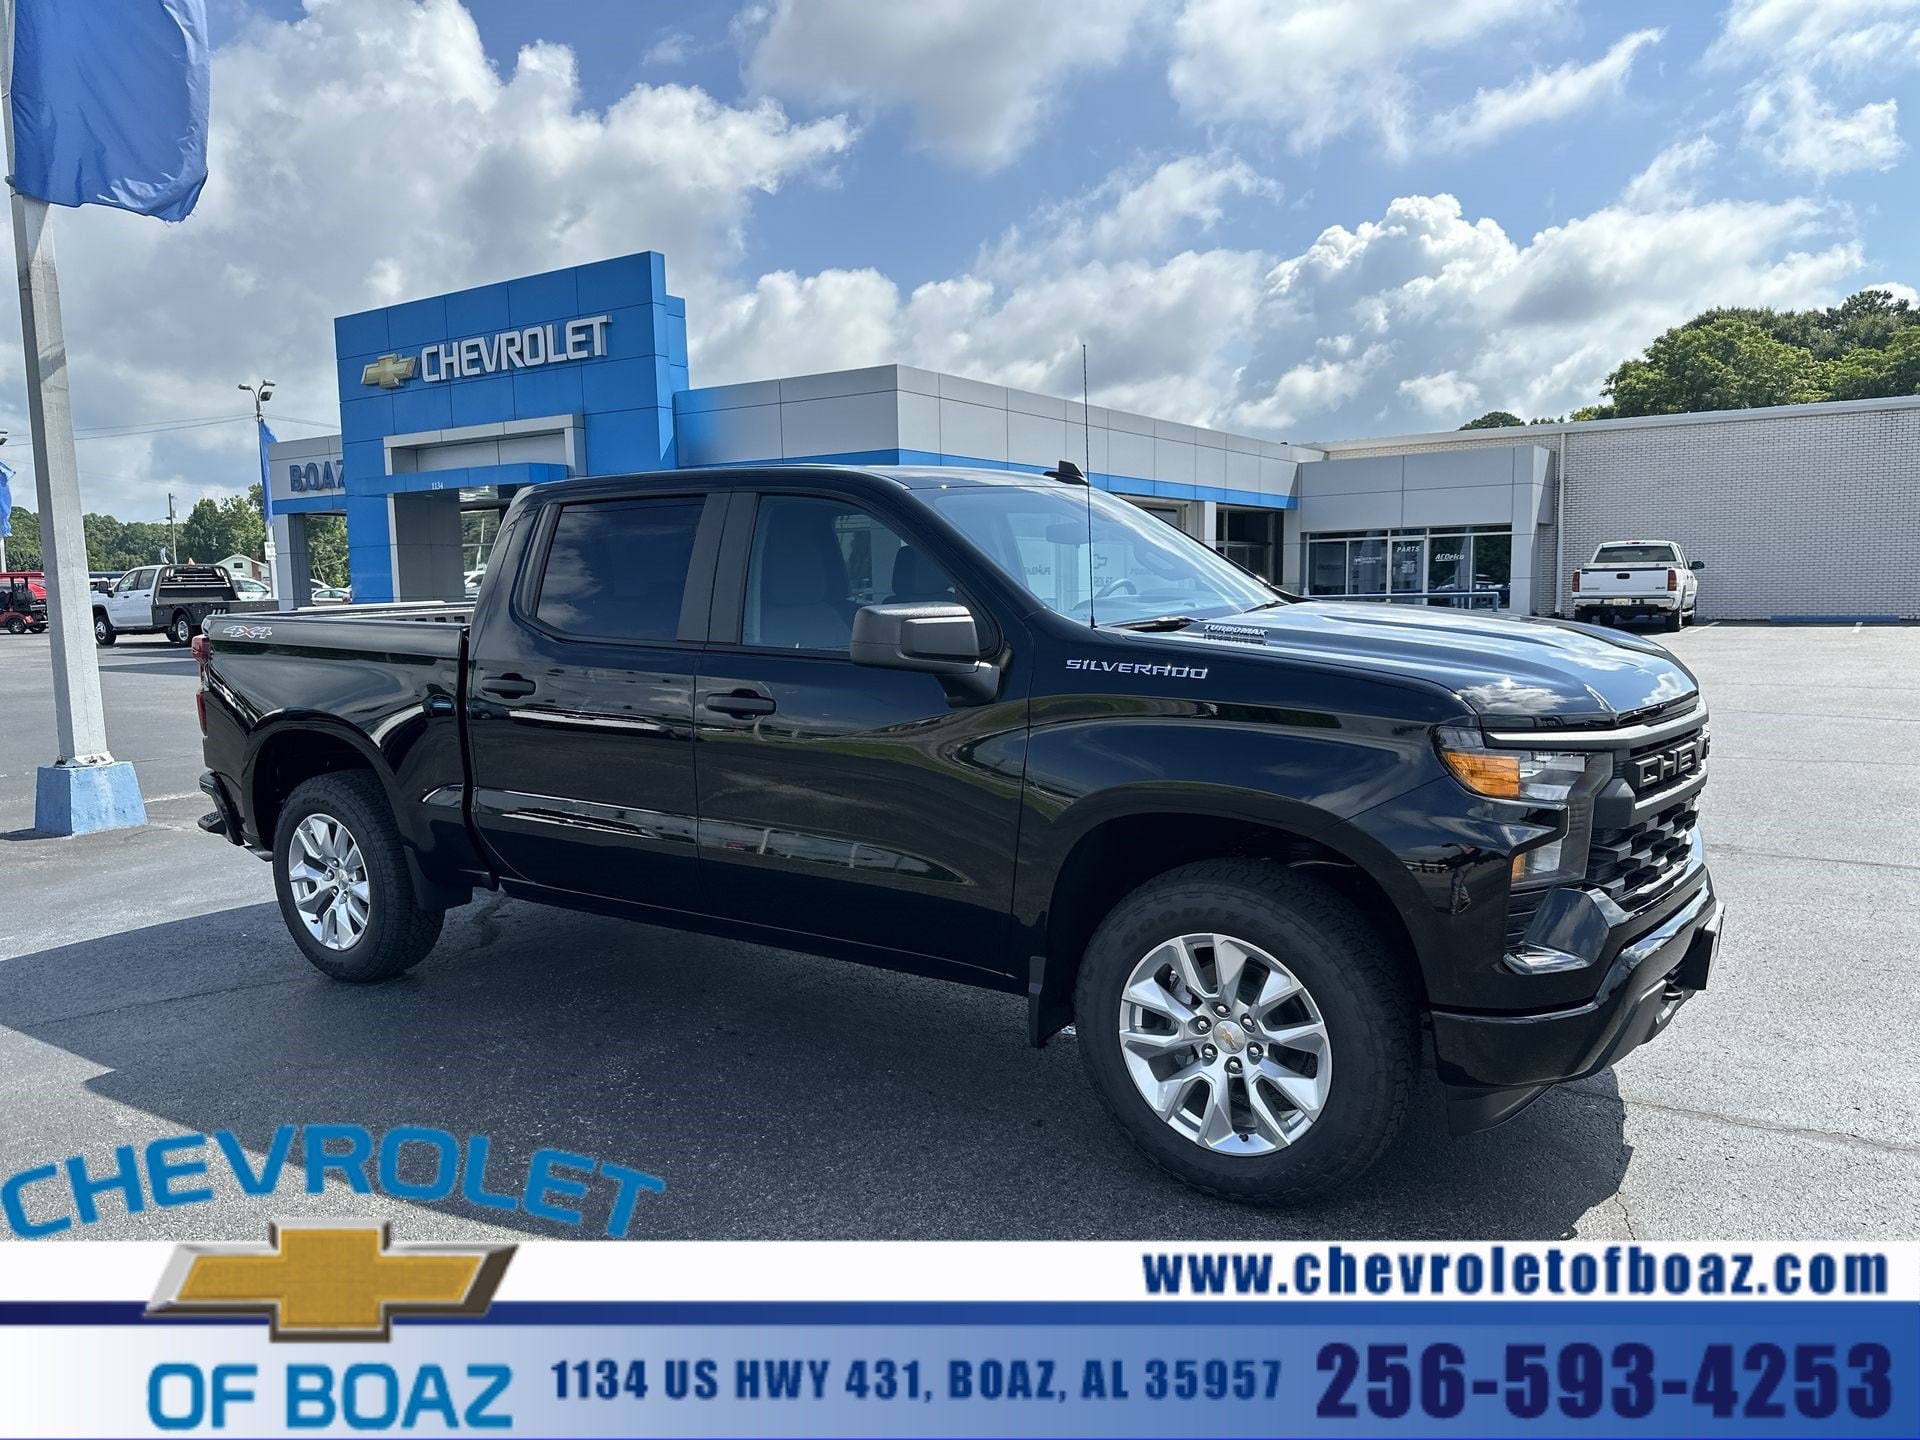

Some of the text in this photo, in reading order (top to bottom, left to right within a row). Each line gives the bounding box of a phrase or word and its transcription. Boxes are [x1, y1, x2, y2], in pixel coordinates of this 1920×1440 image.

[421, 314, 612, 382] CHEVROLET
[431, 481, 444, 490] 1134
[1396, 545, 1420, 553] PARTS
[1434, 553, 1465, 562] ACDelco
[1203, 623, 1269, 637] TURBOMAX
[1066, 658, 1208, 680] SILVERADO
